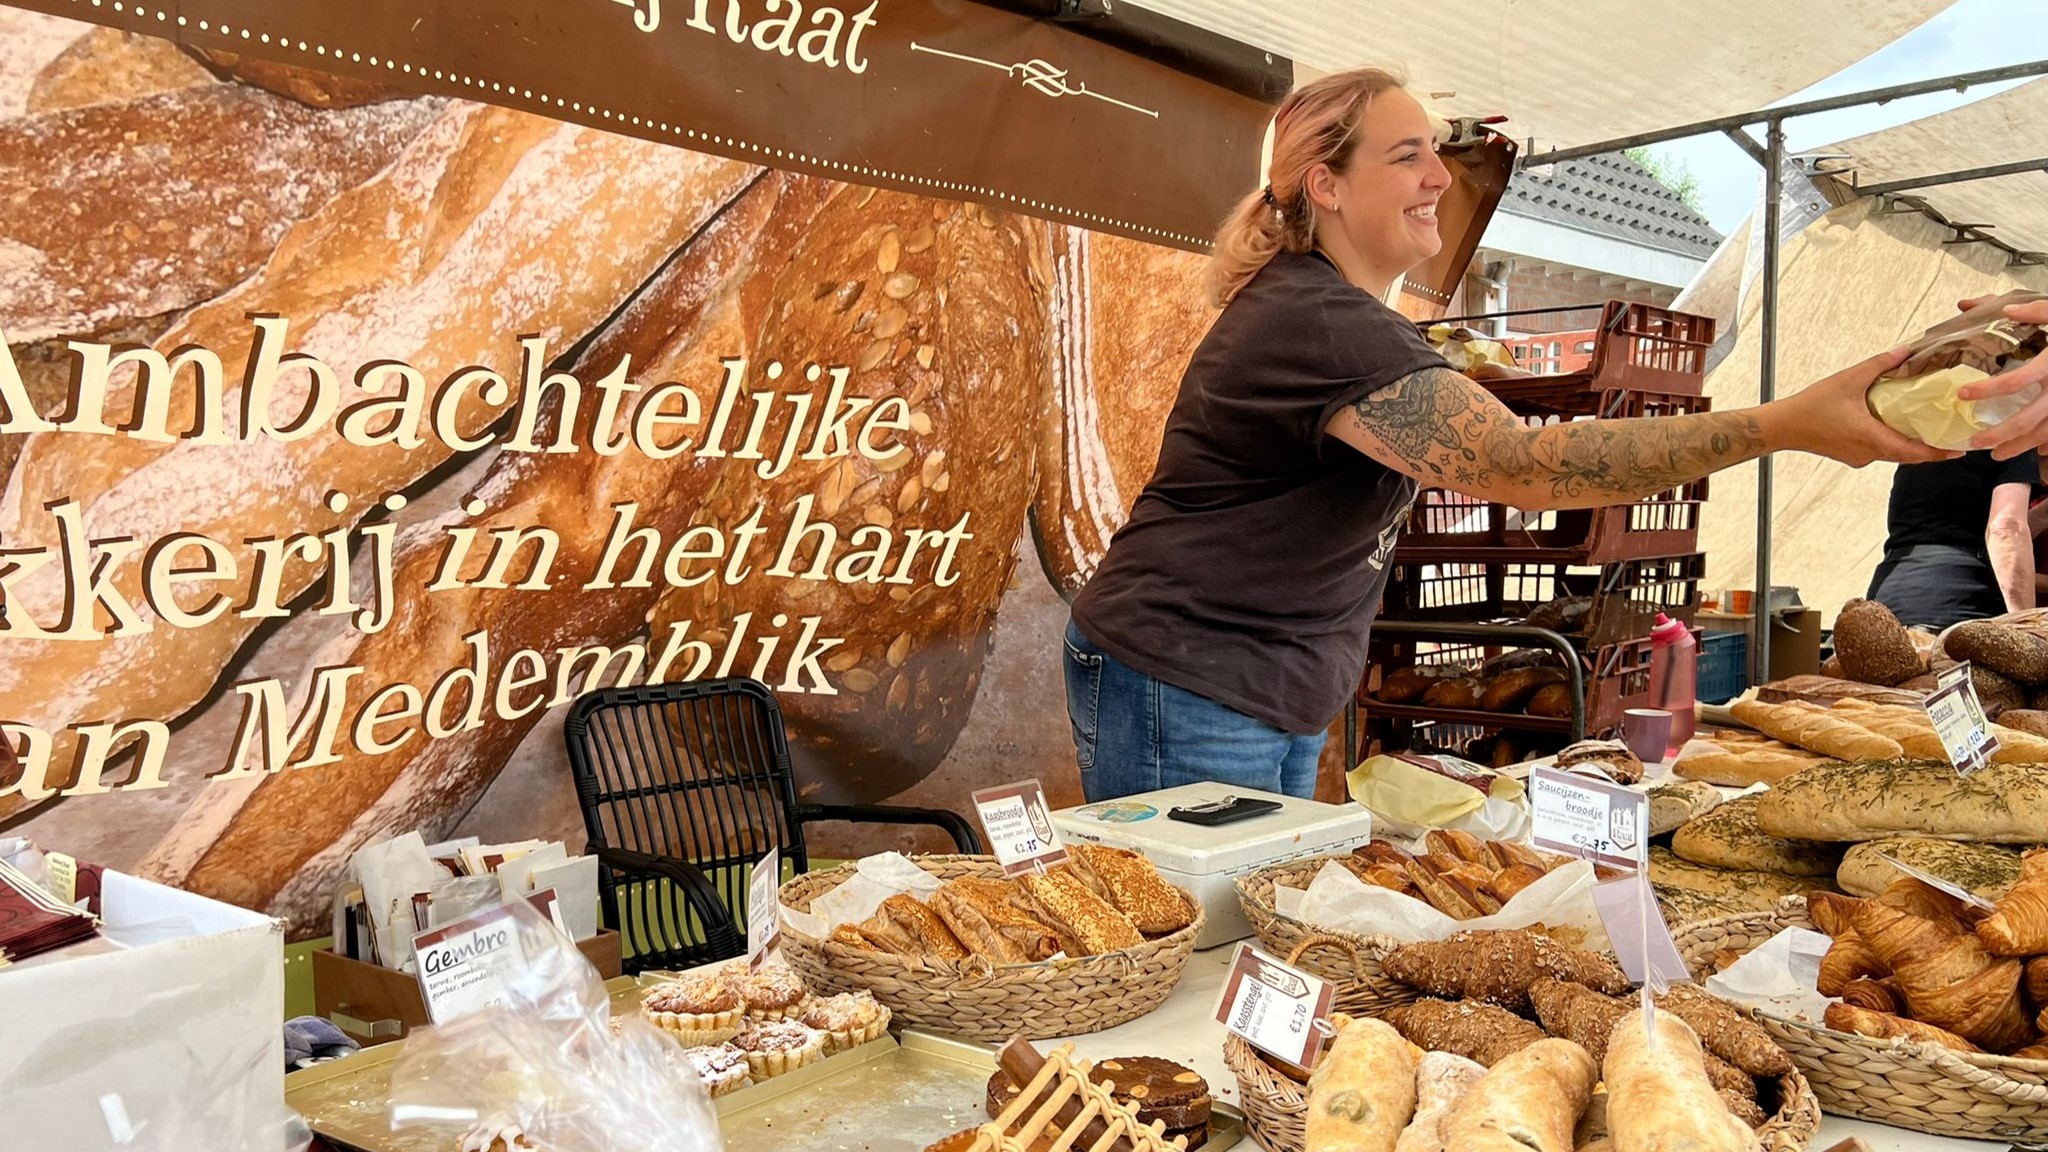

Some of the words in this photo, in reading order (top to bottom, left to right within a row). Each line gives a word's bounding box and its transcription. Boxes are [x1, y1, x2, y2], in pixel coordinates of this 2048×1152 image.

[429, 499, 560, 592] in
[583, 502, 767, 590] het
[764, 493, 974, 588] hart
[212, 611, 846, 783] Medemblik
[1538, 781, 1592, 800] Saucijzen-
[983, 804, 1025, 820] Kaasbroodje
[1565, 801, 1603, 820] broodje
[1014, 839, 1038, 854] €2,75
[1571, 833, 1610, 851] €275
[425, 929, 507, 973] Gembro
[1233, 978, 1263, 1032] Kaasstengel
[1289, 1003, 1307, 1034] €1,70
